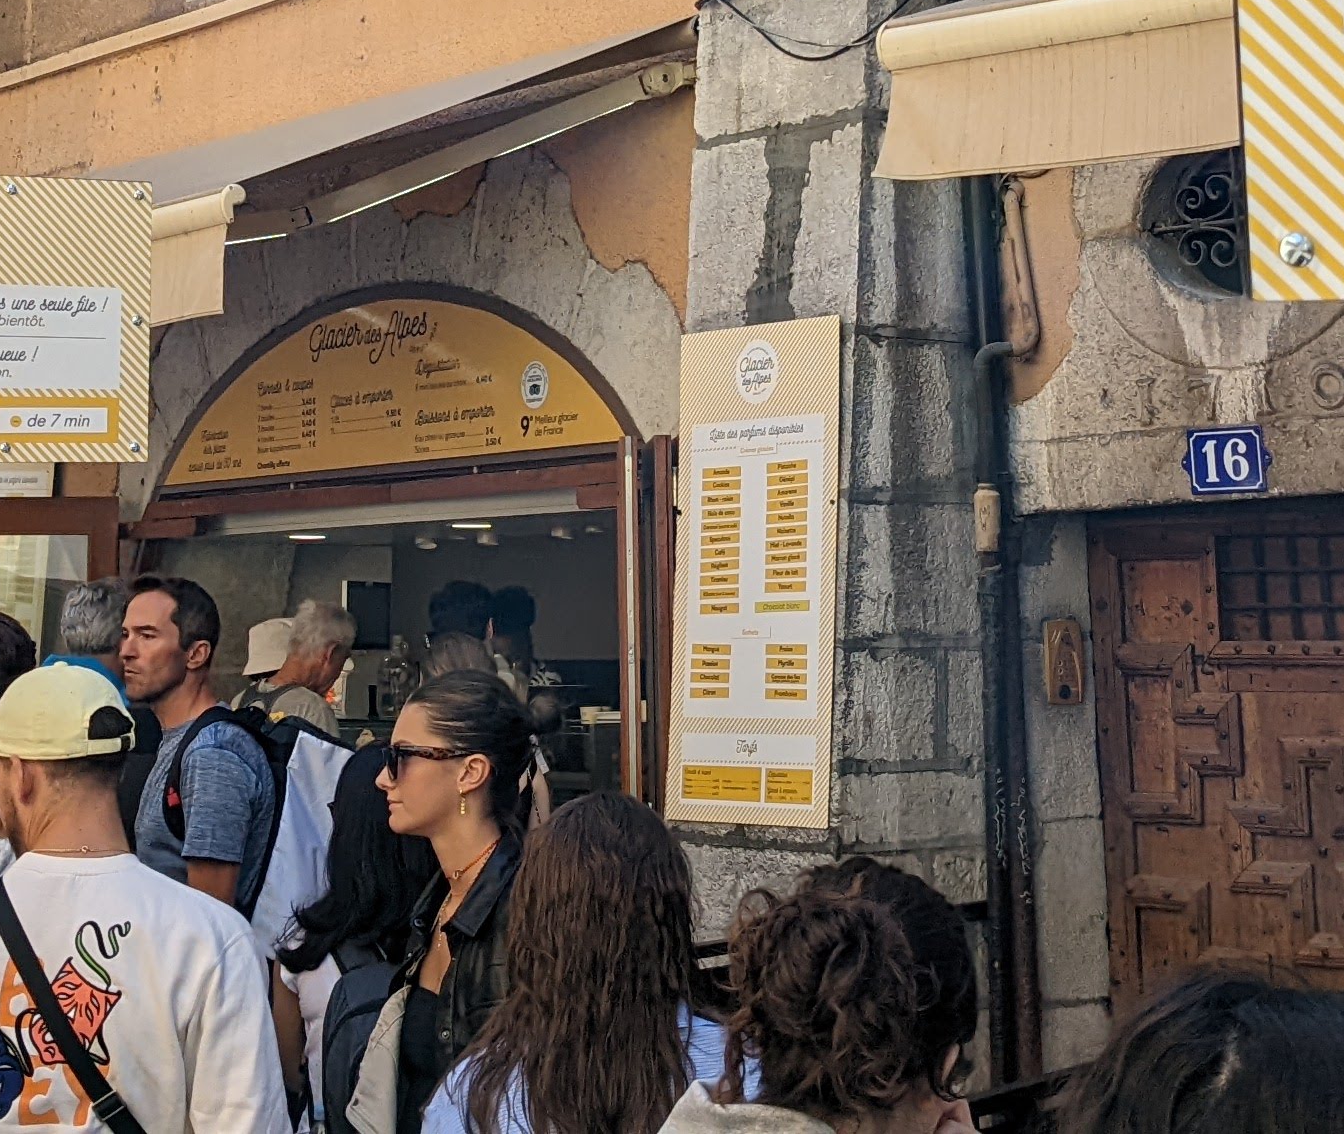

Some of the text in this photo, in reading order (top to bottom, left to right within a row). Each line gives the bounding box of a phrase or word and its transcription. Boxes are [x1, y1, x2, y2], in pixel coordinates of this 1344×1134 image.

[11, 297, 36, 311] une
[39, 297, 74, 311] seule
[71, 295, 97, 317] file
[310, 310, 427, 364] Glacier des Alpes
[740, 357, 774, 378] Glacier
[27, 413, 90, 427] de 7 min
[1201, 438, 1250, 483] 16
